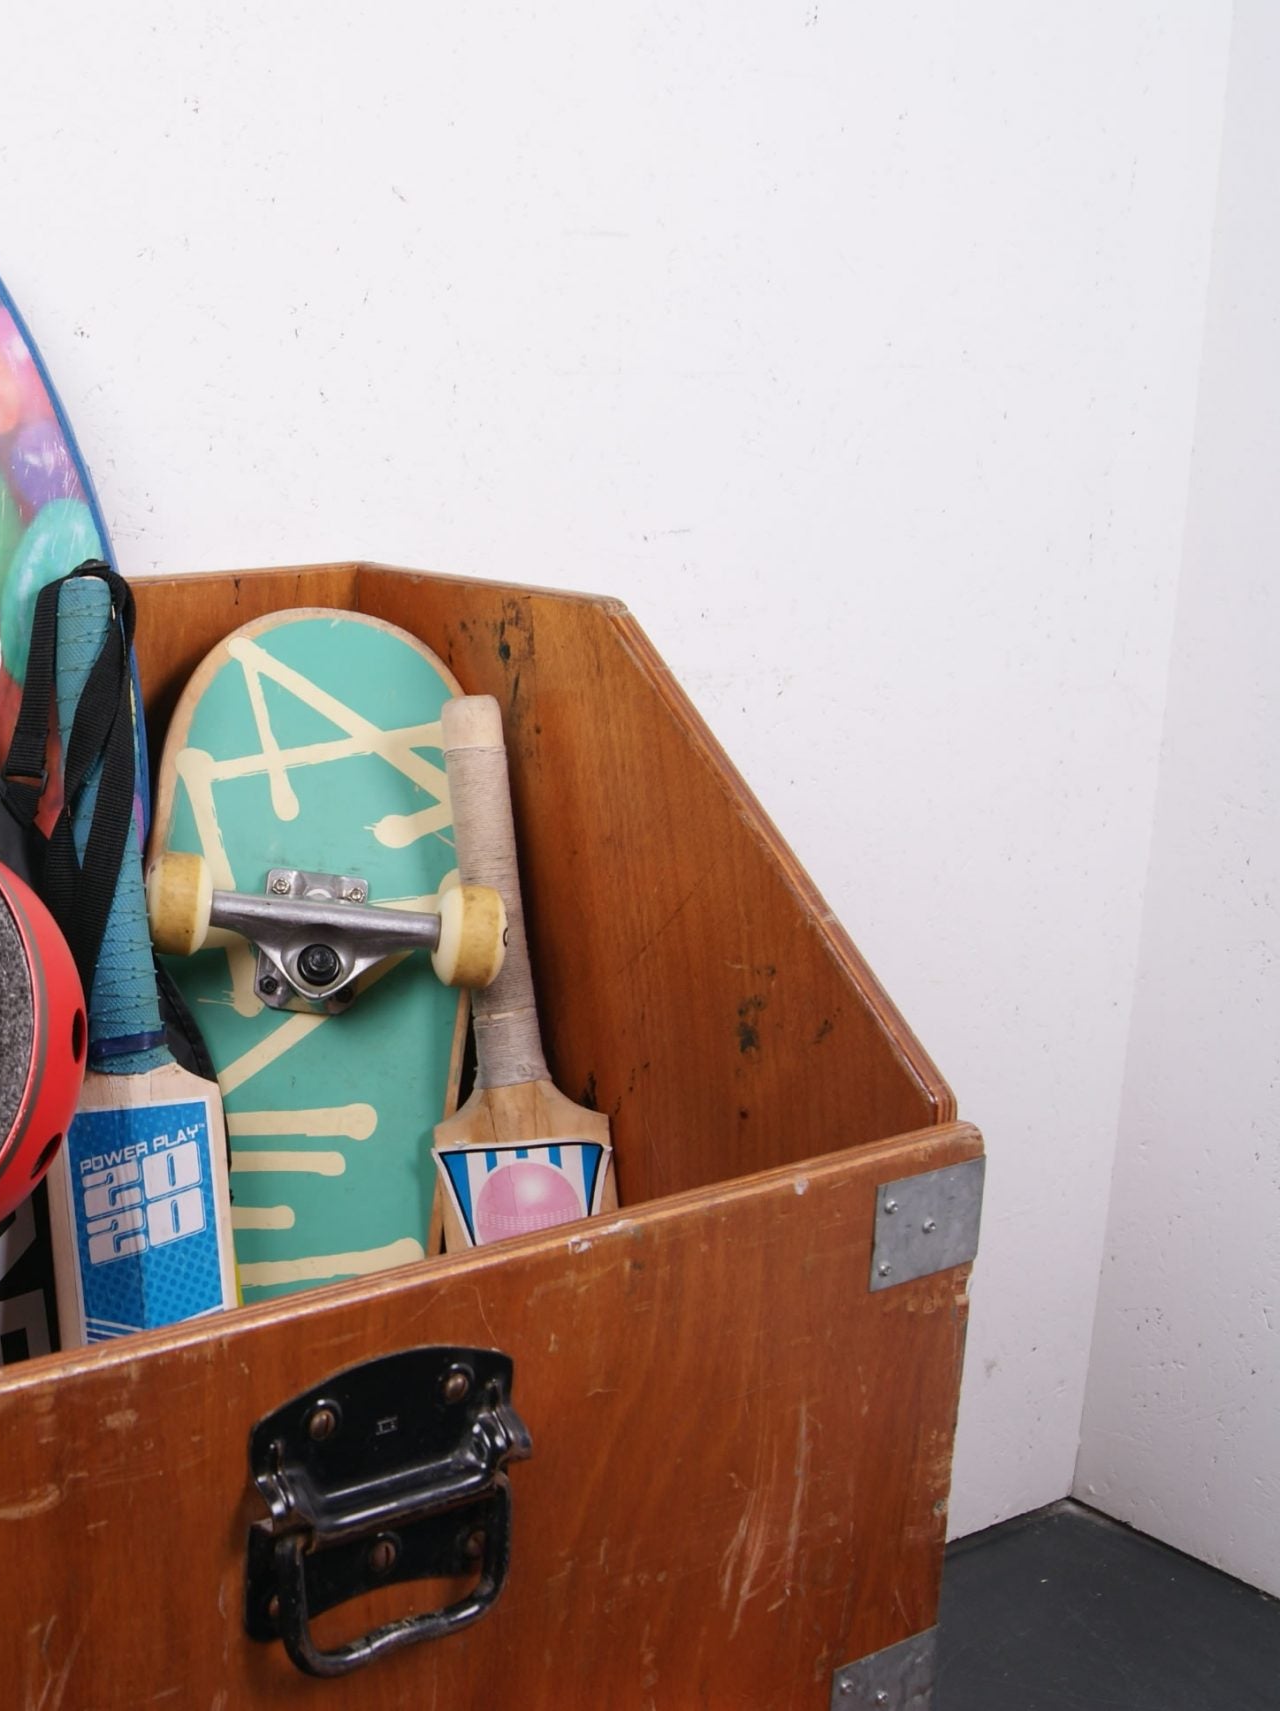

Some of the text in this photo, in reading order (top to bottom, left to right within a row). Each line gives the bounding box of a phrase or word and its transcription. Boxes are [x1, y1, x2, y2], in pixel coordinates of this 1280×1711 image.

[79, 1140, 149, 1174] POWER
[81, 1140, 203, 1220] 20
[86, 1186, 207, 1267] 20
